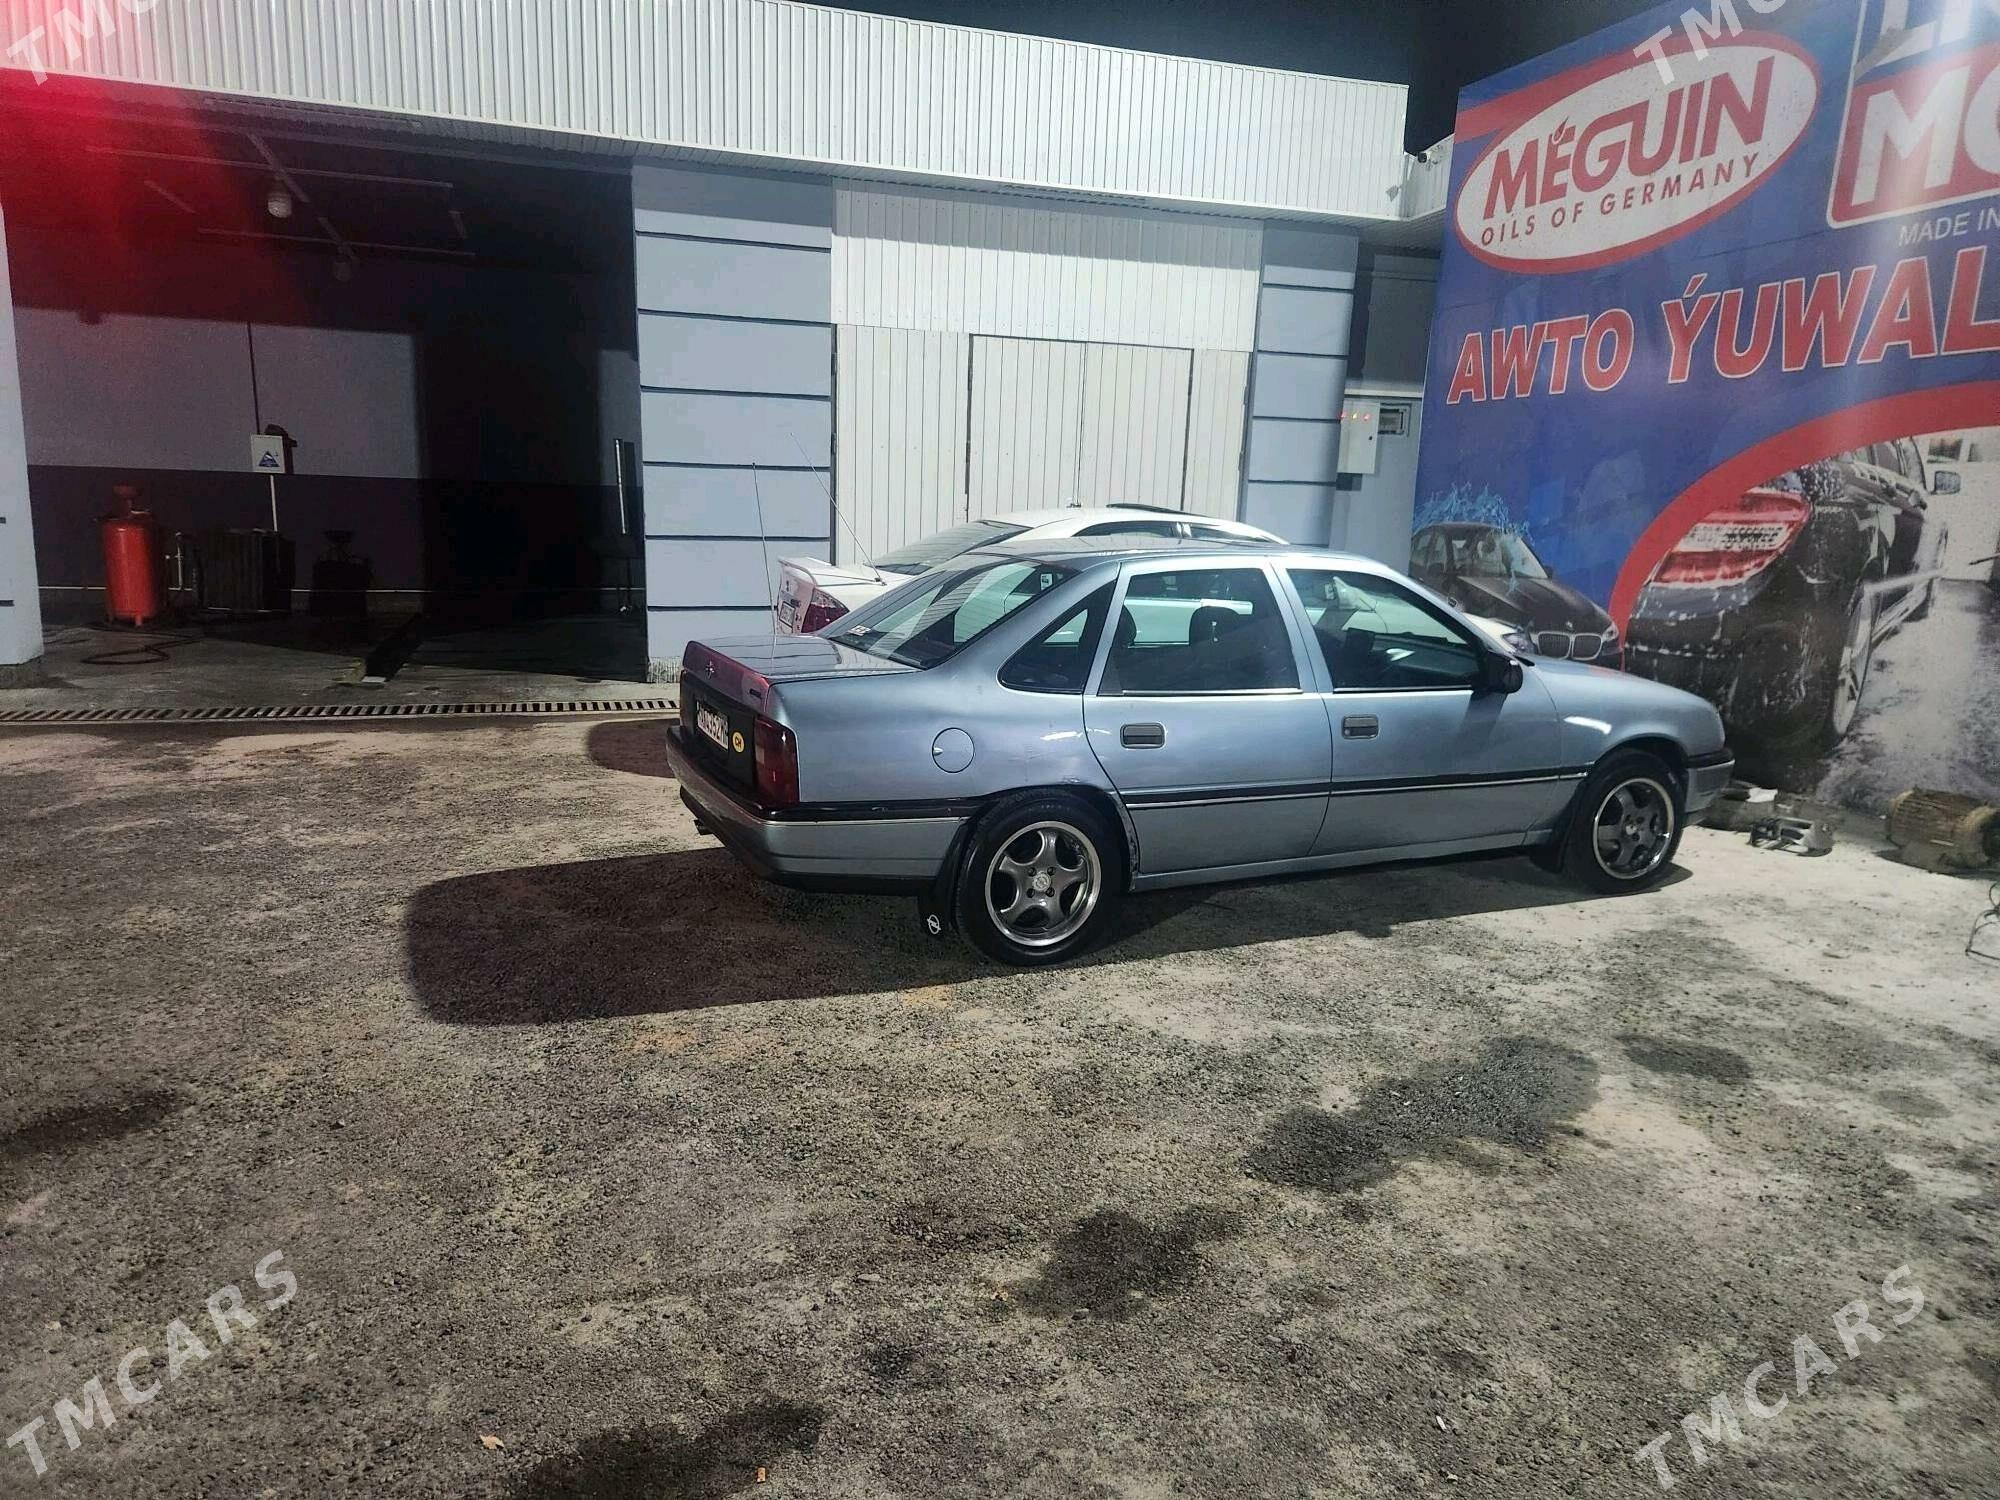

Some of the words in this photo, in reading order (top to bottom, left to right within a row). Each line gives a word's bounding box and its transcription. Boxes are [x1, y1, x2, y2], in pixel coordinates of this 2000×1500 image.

[1481, 214, 1536, 247] OILS
[1551, 201, 1583, 226] OF
[1600, 152, 1760, 216] GERMANY
[1899, 212, 1970, 246] MADE
[1446, 308, 1635, 405] AWTO
